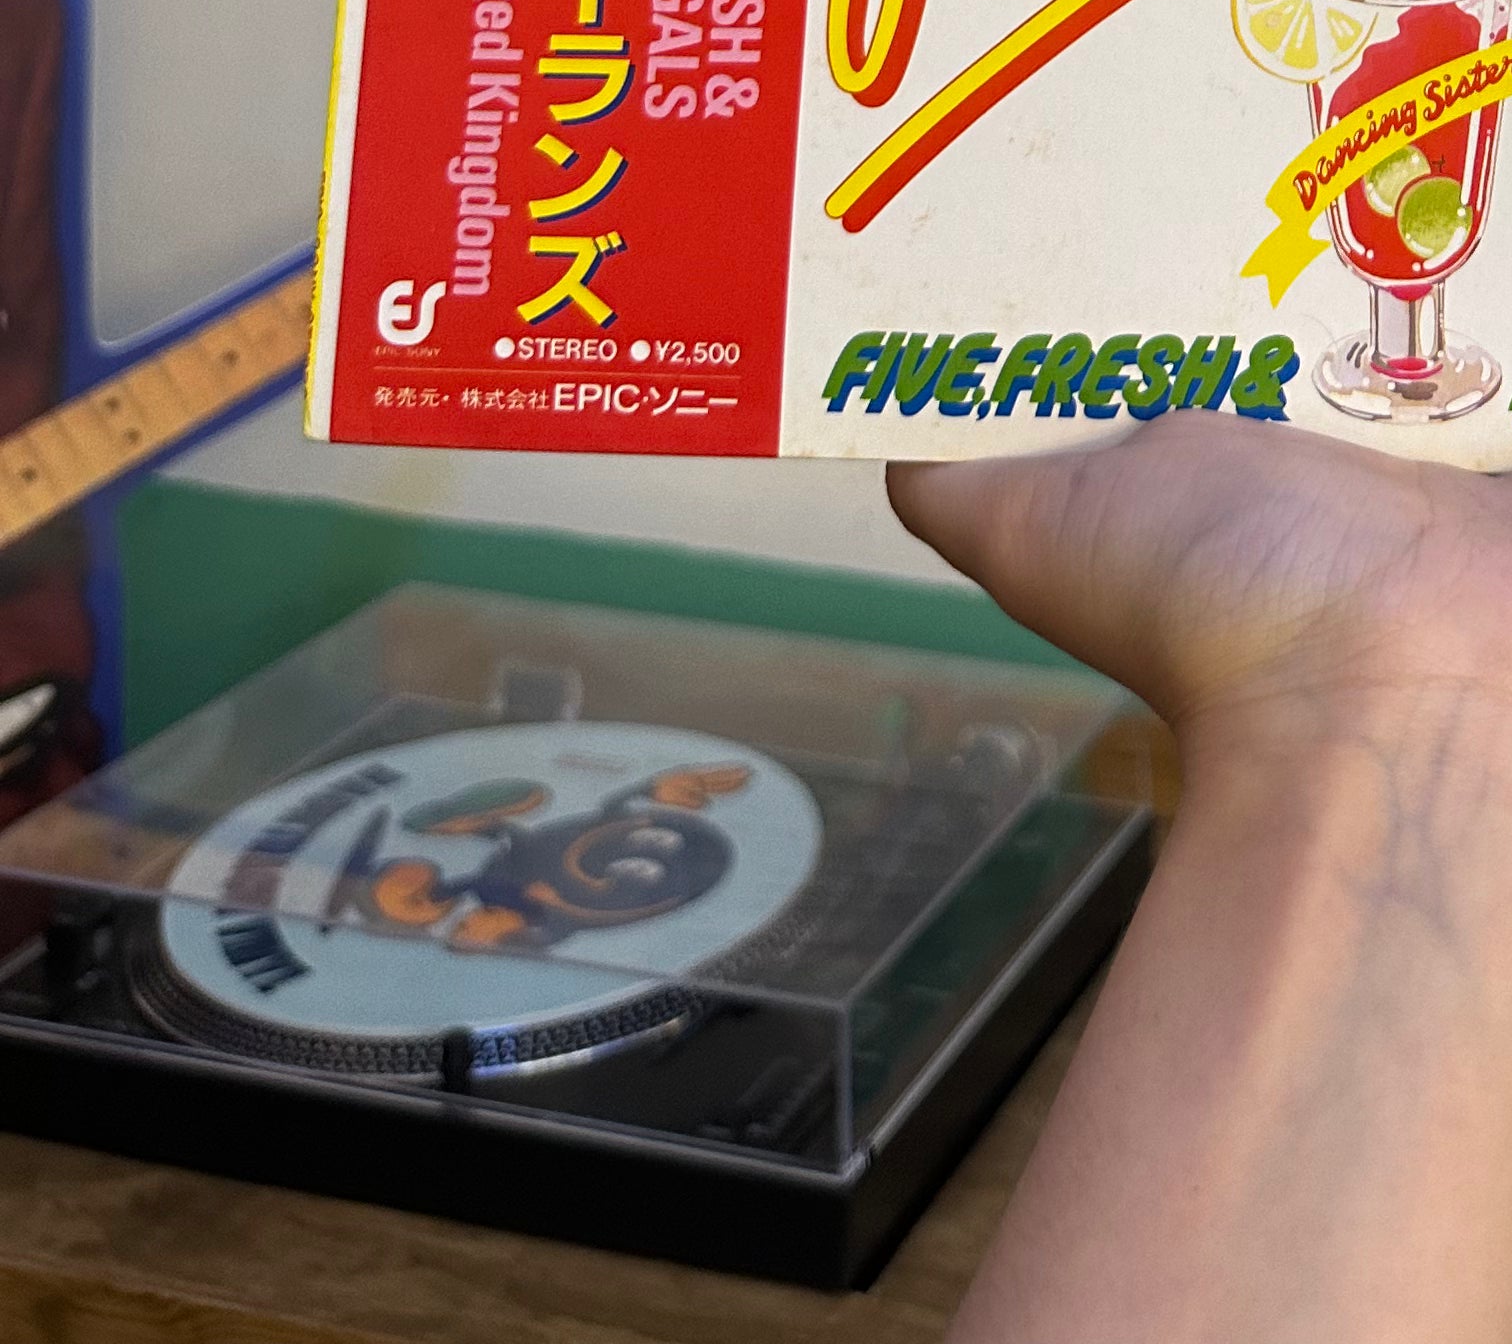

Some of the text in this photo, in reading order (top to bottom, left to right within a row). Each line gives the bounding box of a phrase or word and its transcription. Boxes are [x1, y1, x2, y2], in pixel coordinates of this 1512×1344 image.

[704, 73, 761, 119] &
[447, 72, 522, 297] Kingdom
[1292, 99, 1417, 211] Dancing
[517, 336, 741, 366] STEREO ¥2,500
[988, 332, 1242, 420] FRESH
[1229, 334, 1301, 422] &
